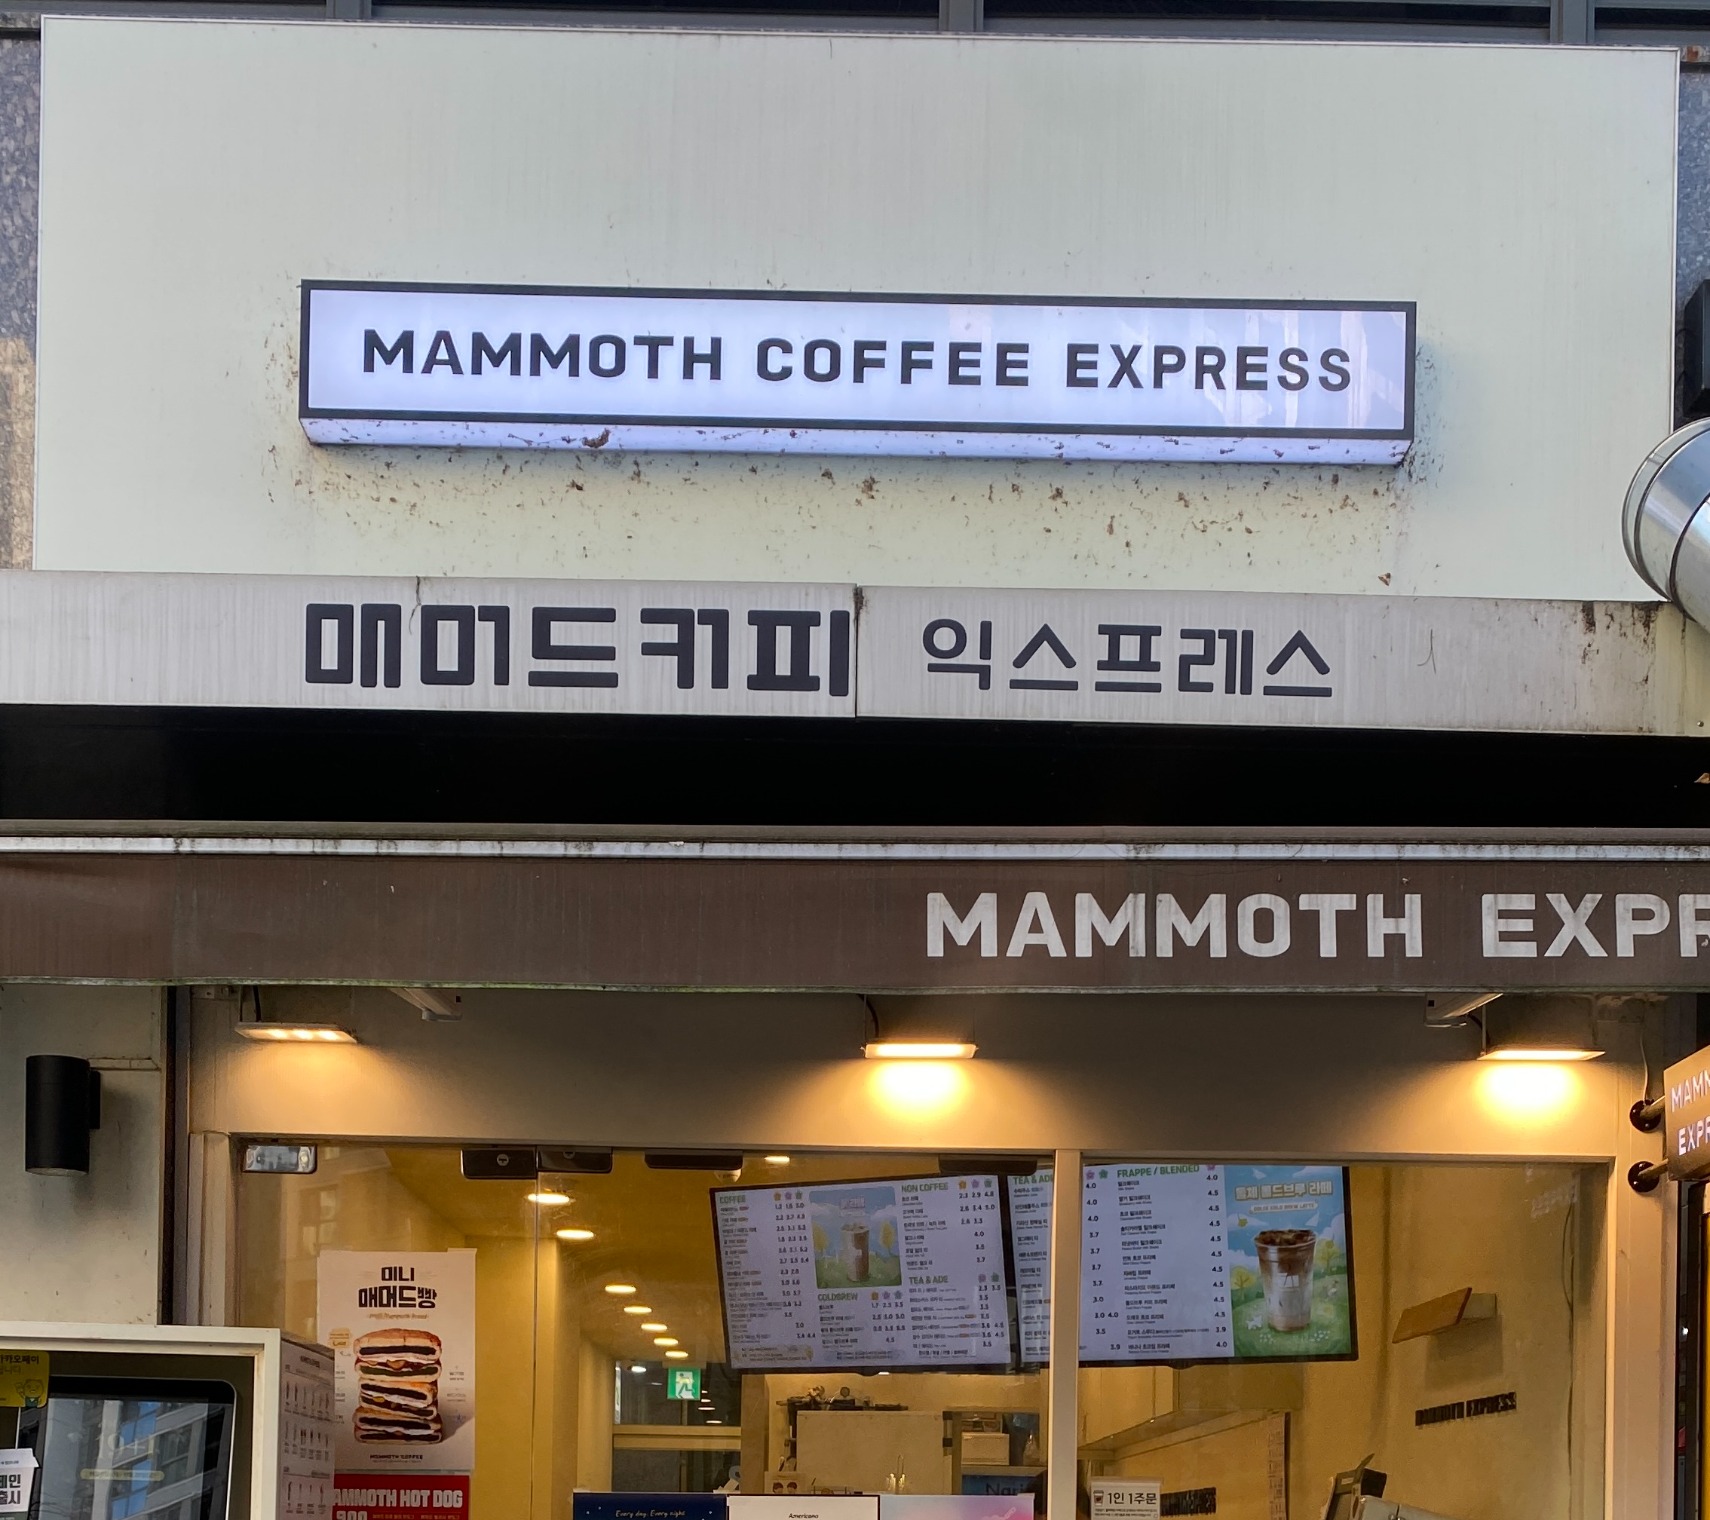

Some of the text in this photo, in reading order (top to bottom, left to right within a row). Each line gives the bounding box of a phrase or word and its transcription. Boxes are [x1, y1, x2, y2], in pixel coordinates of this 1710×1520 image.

[362, 329, 1352, 393] MAMMOTH COFFEE EXPRESS
[924, 617, 1332, 698] 익스프레스
[926, 892, 1421, 959] MAMMOTH
[1117, 1164, 1200, 1178] FRAPPE BLENDED
[902, 1182, 948, 1192] NON COFFEE
[381, 1266, 415, 1282] 미니
[358, 1285, 438, 1309] 매머드빵
[333, 1488, 463, 1508] AMMOTH HOT DOG
[1108, 1492, 1124, 1505] 1인
[1128, 1492, 1157, 1505] 1주문
